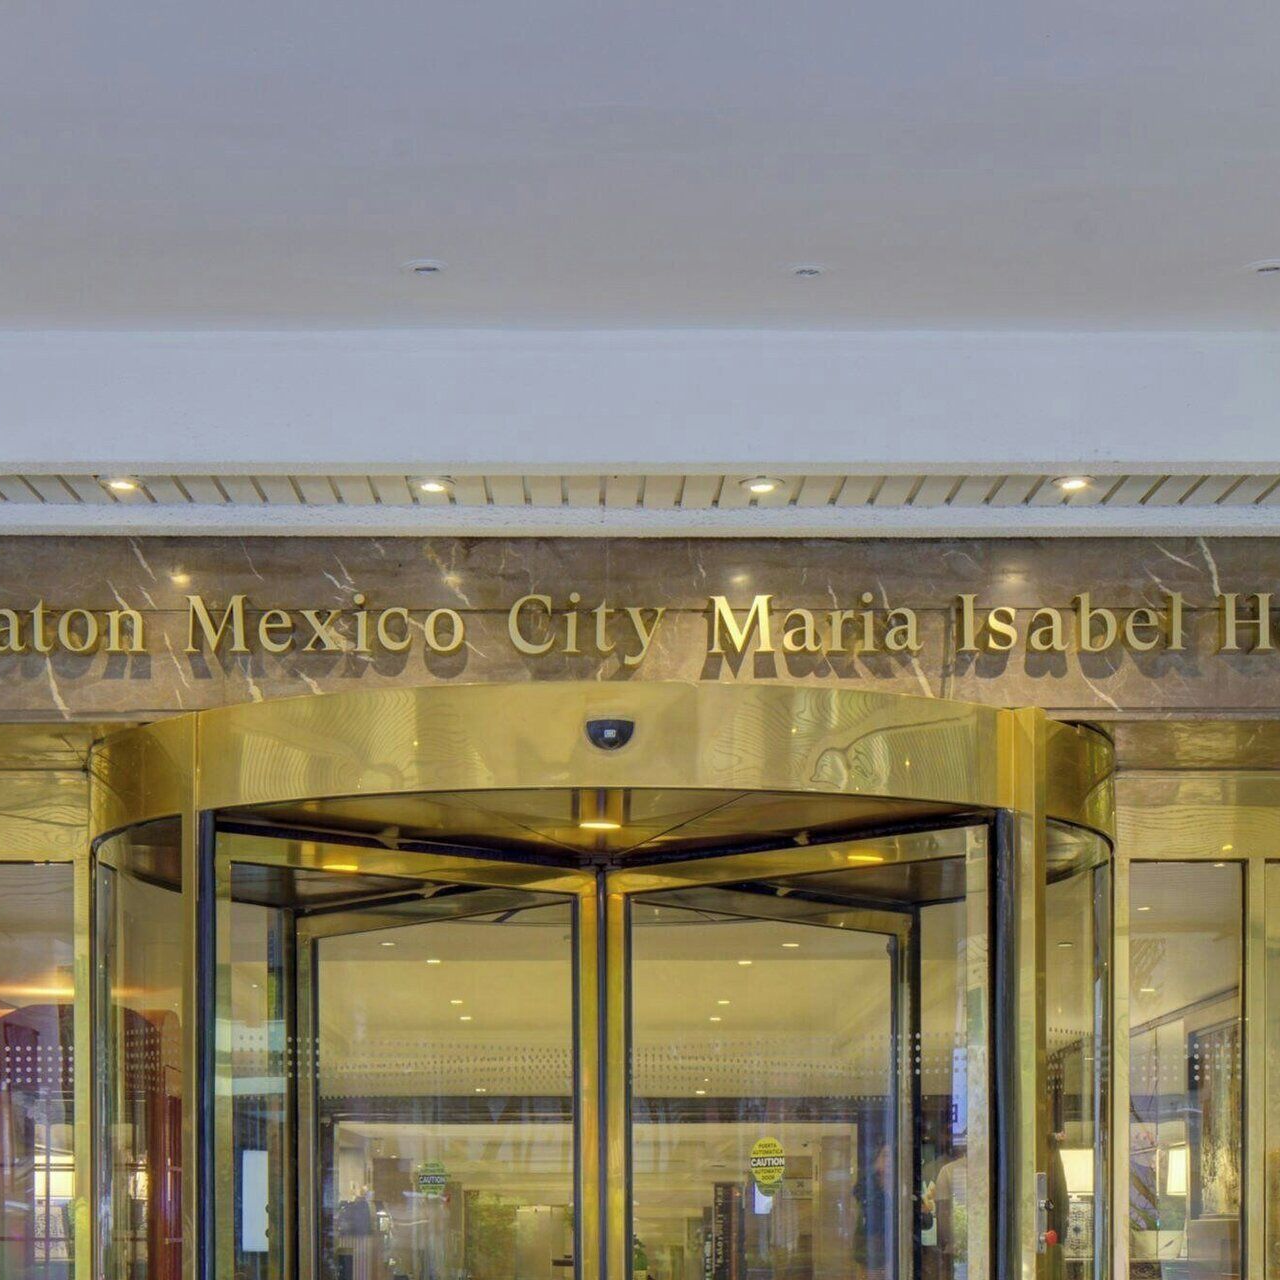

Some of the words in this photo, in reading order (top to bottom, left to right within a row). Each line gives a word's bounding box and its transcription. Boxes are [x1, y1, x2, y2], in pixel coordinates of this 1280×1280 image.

[183, 592, 465, 654] Mexico
[507, 591, 667, 666] City
[708, 591, 925, 654] Maria
[957, 591, 1187, 653] Isabel
[751, 1157, 785, 1167] CAUTION
